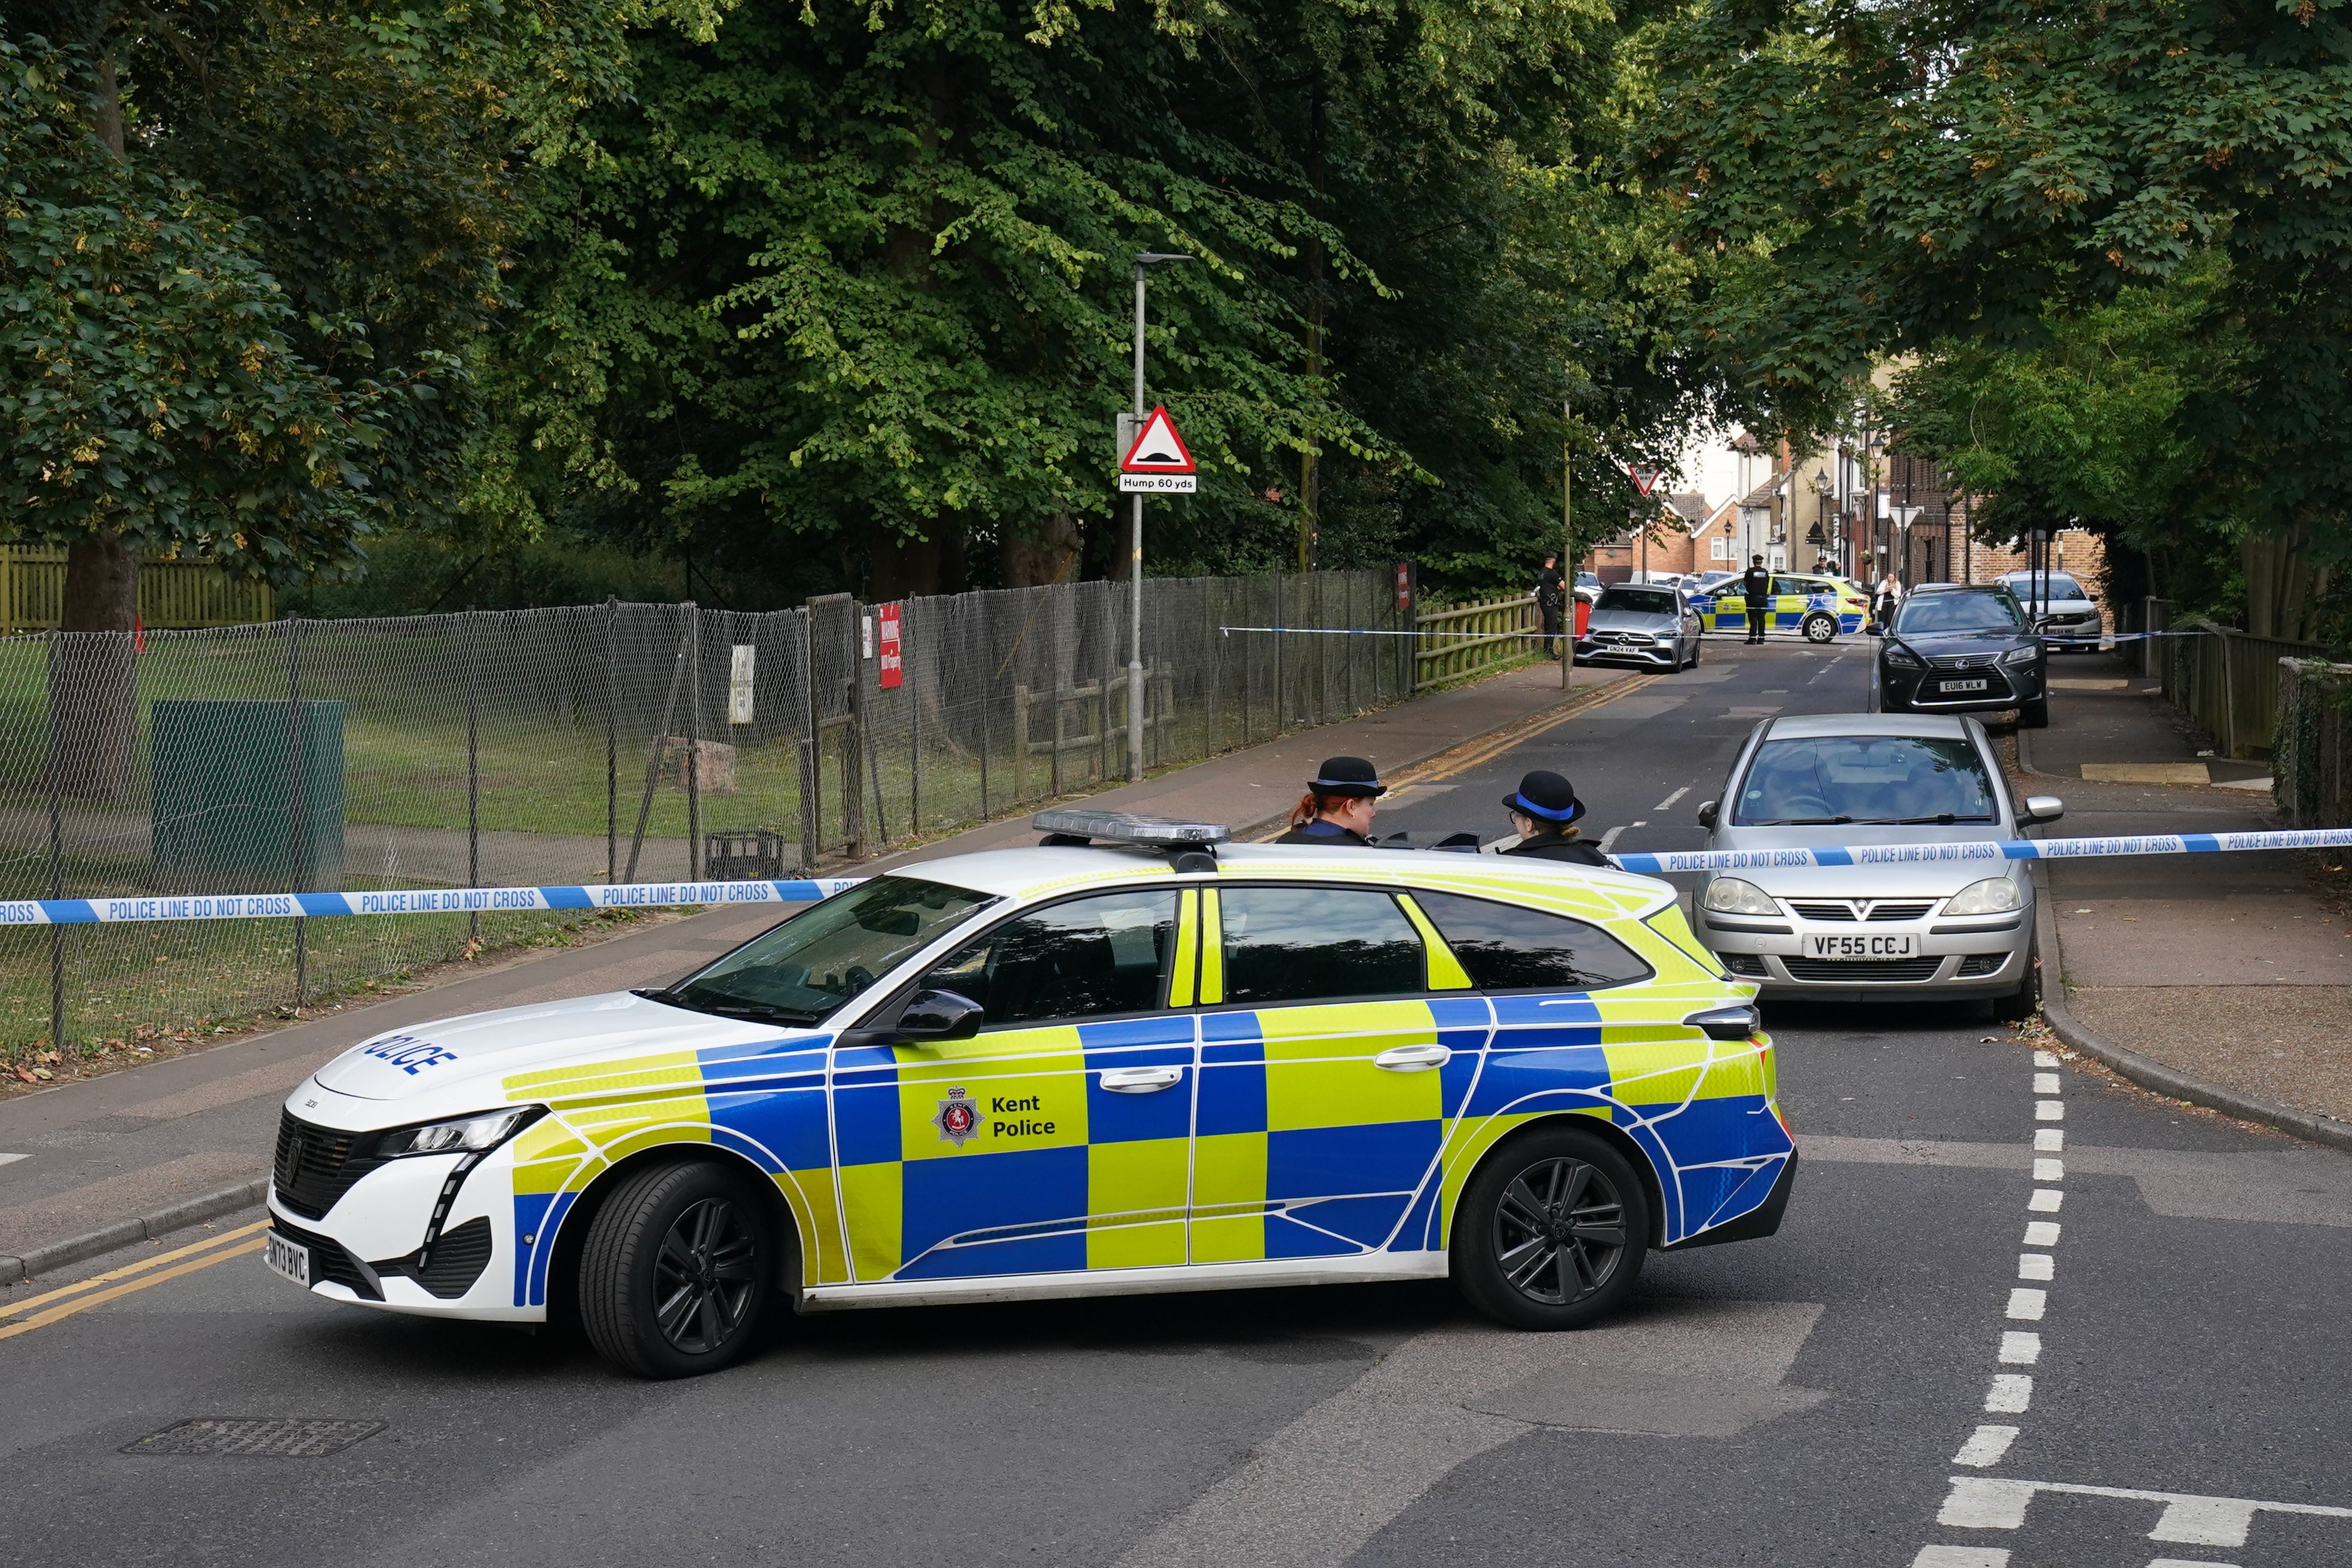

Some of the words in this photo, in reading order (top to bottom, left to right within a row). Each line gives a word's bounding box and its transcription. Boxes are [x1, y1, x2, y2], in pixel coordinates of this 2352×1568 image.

[1124, 479, 1154, 488] Hump
[1158, 479, 1172, 488] 60
[1175, 480, 1193, 489] yds
[1945, 682, 1964, 690] EU16
[1965, 681, 1982, 689] WLW
[2046, 841, 2081, 856] POLICE
[2082, 840, 2105, 855] LINE
[2106, 840, 2121, 854] DO
[2122, 838, 2142, 853] NOT
[2145, 837, 2177, 852] CROSS
[2227, 835, 2262, 849] POLICE
[2262, 834, 2283, 847] LINE
[2286, 833, 2300, 847] DO
[2301, 832, 2321, 846] NOT
[2323, 830, 2352, 845] CROSS
[1668, 855, 1706, 870] POLICE
[1707, 854, 1731, 869] LINE
[1732, 853, 1748, 868] DO
[1751, 852, 1771, 867] NOT
[1774, 851, 1808, 866] CROSS
[1861, 849, 1896, 863] POLICE
[1897, 847, 1919, 862] LINE
[1922, 846, 1937, 861] DO
[1940, 846, 1959, 861] NOT
[1961, 844, 1995, 859] CROSS
[362, 894, 407, 912] POLICE
[409, 893, 439, 911] LINE
[442, 892, 461, 910] DO
[463, 892, 490, 909] NOT
[492, 890, 535, 908] CROSS
[602, 887, 646, 905] POLICE
[648, 886, 676, 904] LINE
[679, 886, 697, 903] DO
[700, 885, 725, 902] NOT
[727, 884, 769, 901] CROSS
[0, 904, 35, 922] ROSS
[109, 901, 157, 920] POLICE
[160, 901, 189, 918] LINE
[193, 899, 213, 917] DO
[216, 898, 244, 916] NOT
[247, 897, 291, 915] CROSS
[1814, 937, 1866, 955] VF55
[1872, 937, 1910, 955] CCJ
[353, 1035, 458, 1076] POLICE
[305, 1099, 318, 1108] 308
[992, 1096, 1040, 1113] Kent
[993, 1119, 1056, 1137] Police
[269, 1235, 286, 1272] GN73
[287, 1246, 305, 1281] BYC
